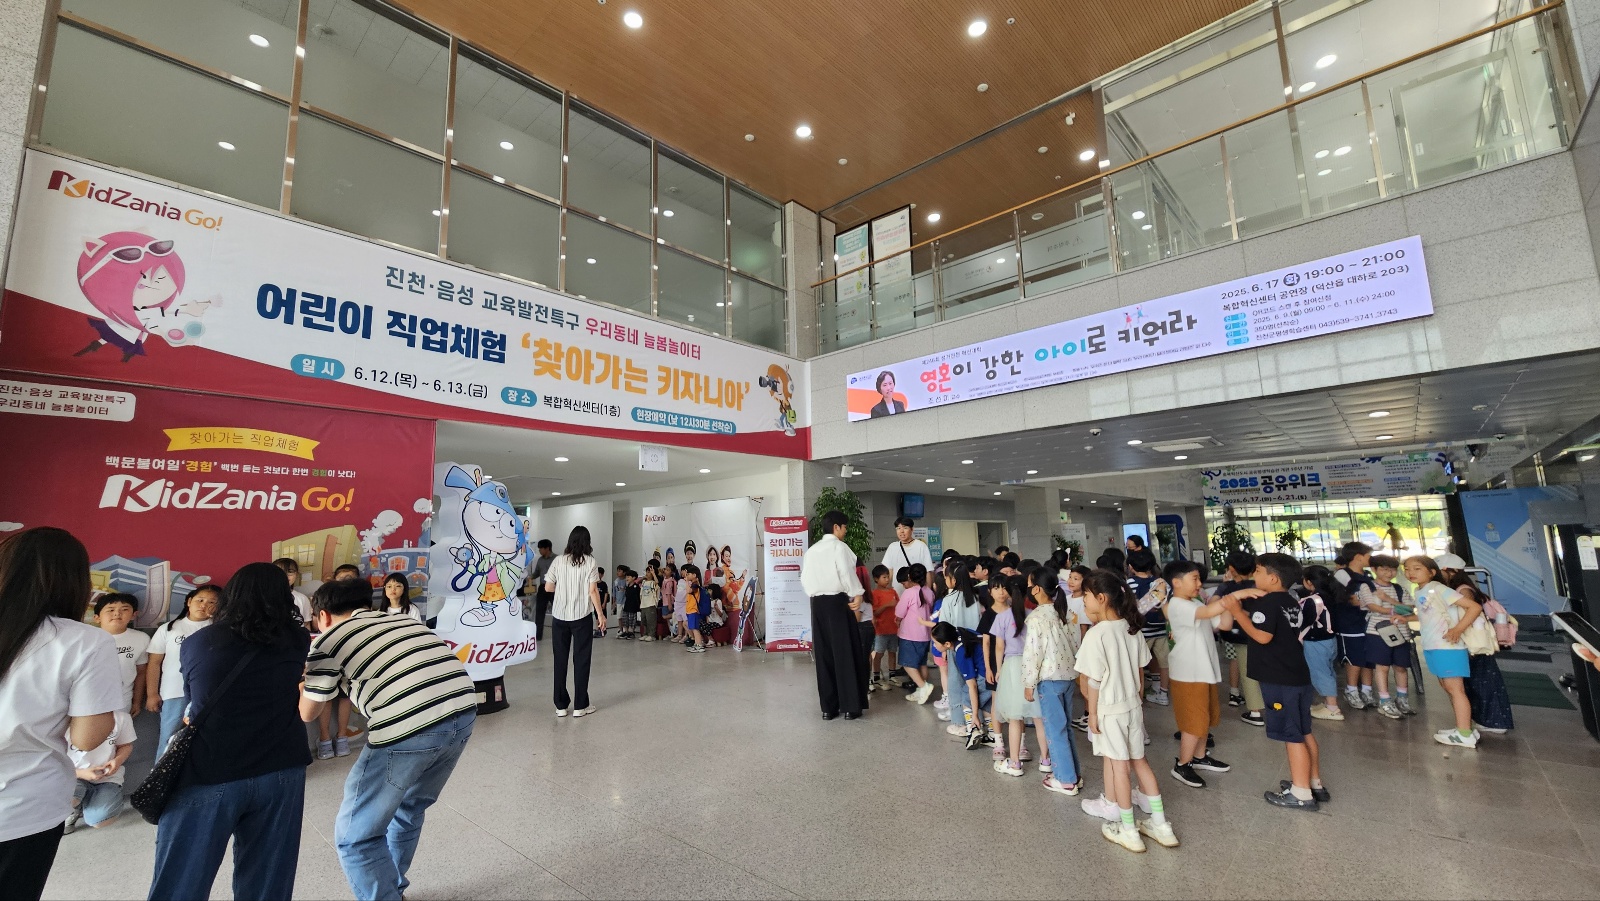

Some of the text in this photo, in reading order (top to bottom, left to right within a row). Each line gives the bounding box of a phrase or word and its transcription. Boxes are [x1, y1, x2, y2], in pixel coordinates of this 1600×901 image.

[48, 170, 223, 231] KidZania Go!
[1304, 264, 1345, 280] 19:00
[1361, 249, 1406, 267] 21:00
[1222, 293, 1277, 311] 복합혁신센터
[1380, 264, 1410, 277] 203)
[1371, 289, 1396, 300] 24:00
[256, 283, 373, 340] 어린이
[386, 309, 508, 364] 직업체험
[385, 265, 702, 360] 진천·음성 교육발전특구 우리동네 늘봄놀이터
[919, 362, 972, 394] 영혼이
[979, 349, 1024, 381] 강한
[1034, 325, 1107, 366] 아이로
[1117, 310, 1198, 347] 키워라
[354, 366, 417, 389] 6.12.(목)
[433, 379, 488, 399] 6.13.(금)
[543, 395, 621, 418] 복합혁신센터(1층)
[636, 408, 667, 425] 현장예약
[679, 414, 710, 431] 12시30분
[711, 420, 733, 434] 선착순)
[189, 431, 300, 452] 찾아가는 직업체험
[263, 465, 290, 475] 것보다
[292, 467, 309, 477] 한번
[1219, 476, 1259, 489] 2025
[1260, 472, 1322, 494] 공유위크
[99, 474, 355, 513] KidZania Go!
[769, 537, 803, 547] 찾아가는
[769, 548, 804, 558] 키자니아
